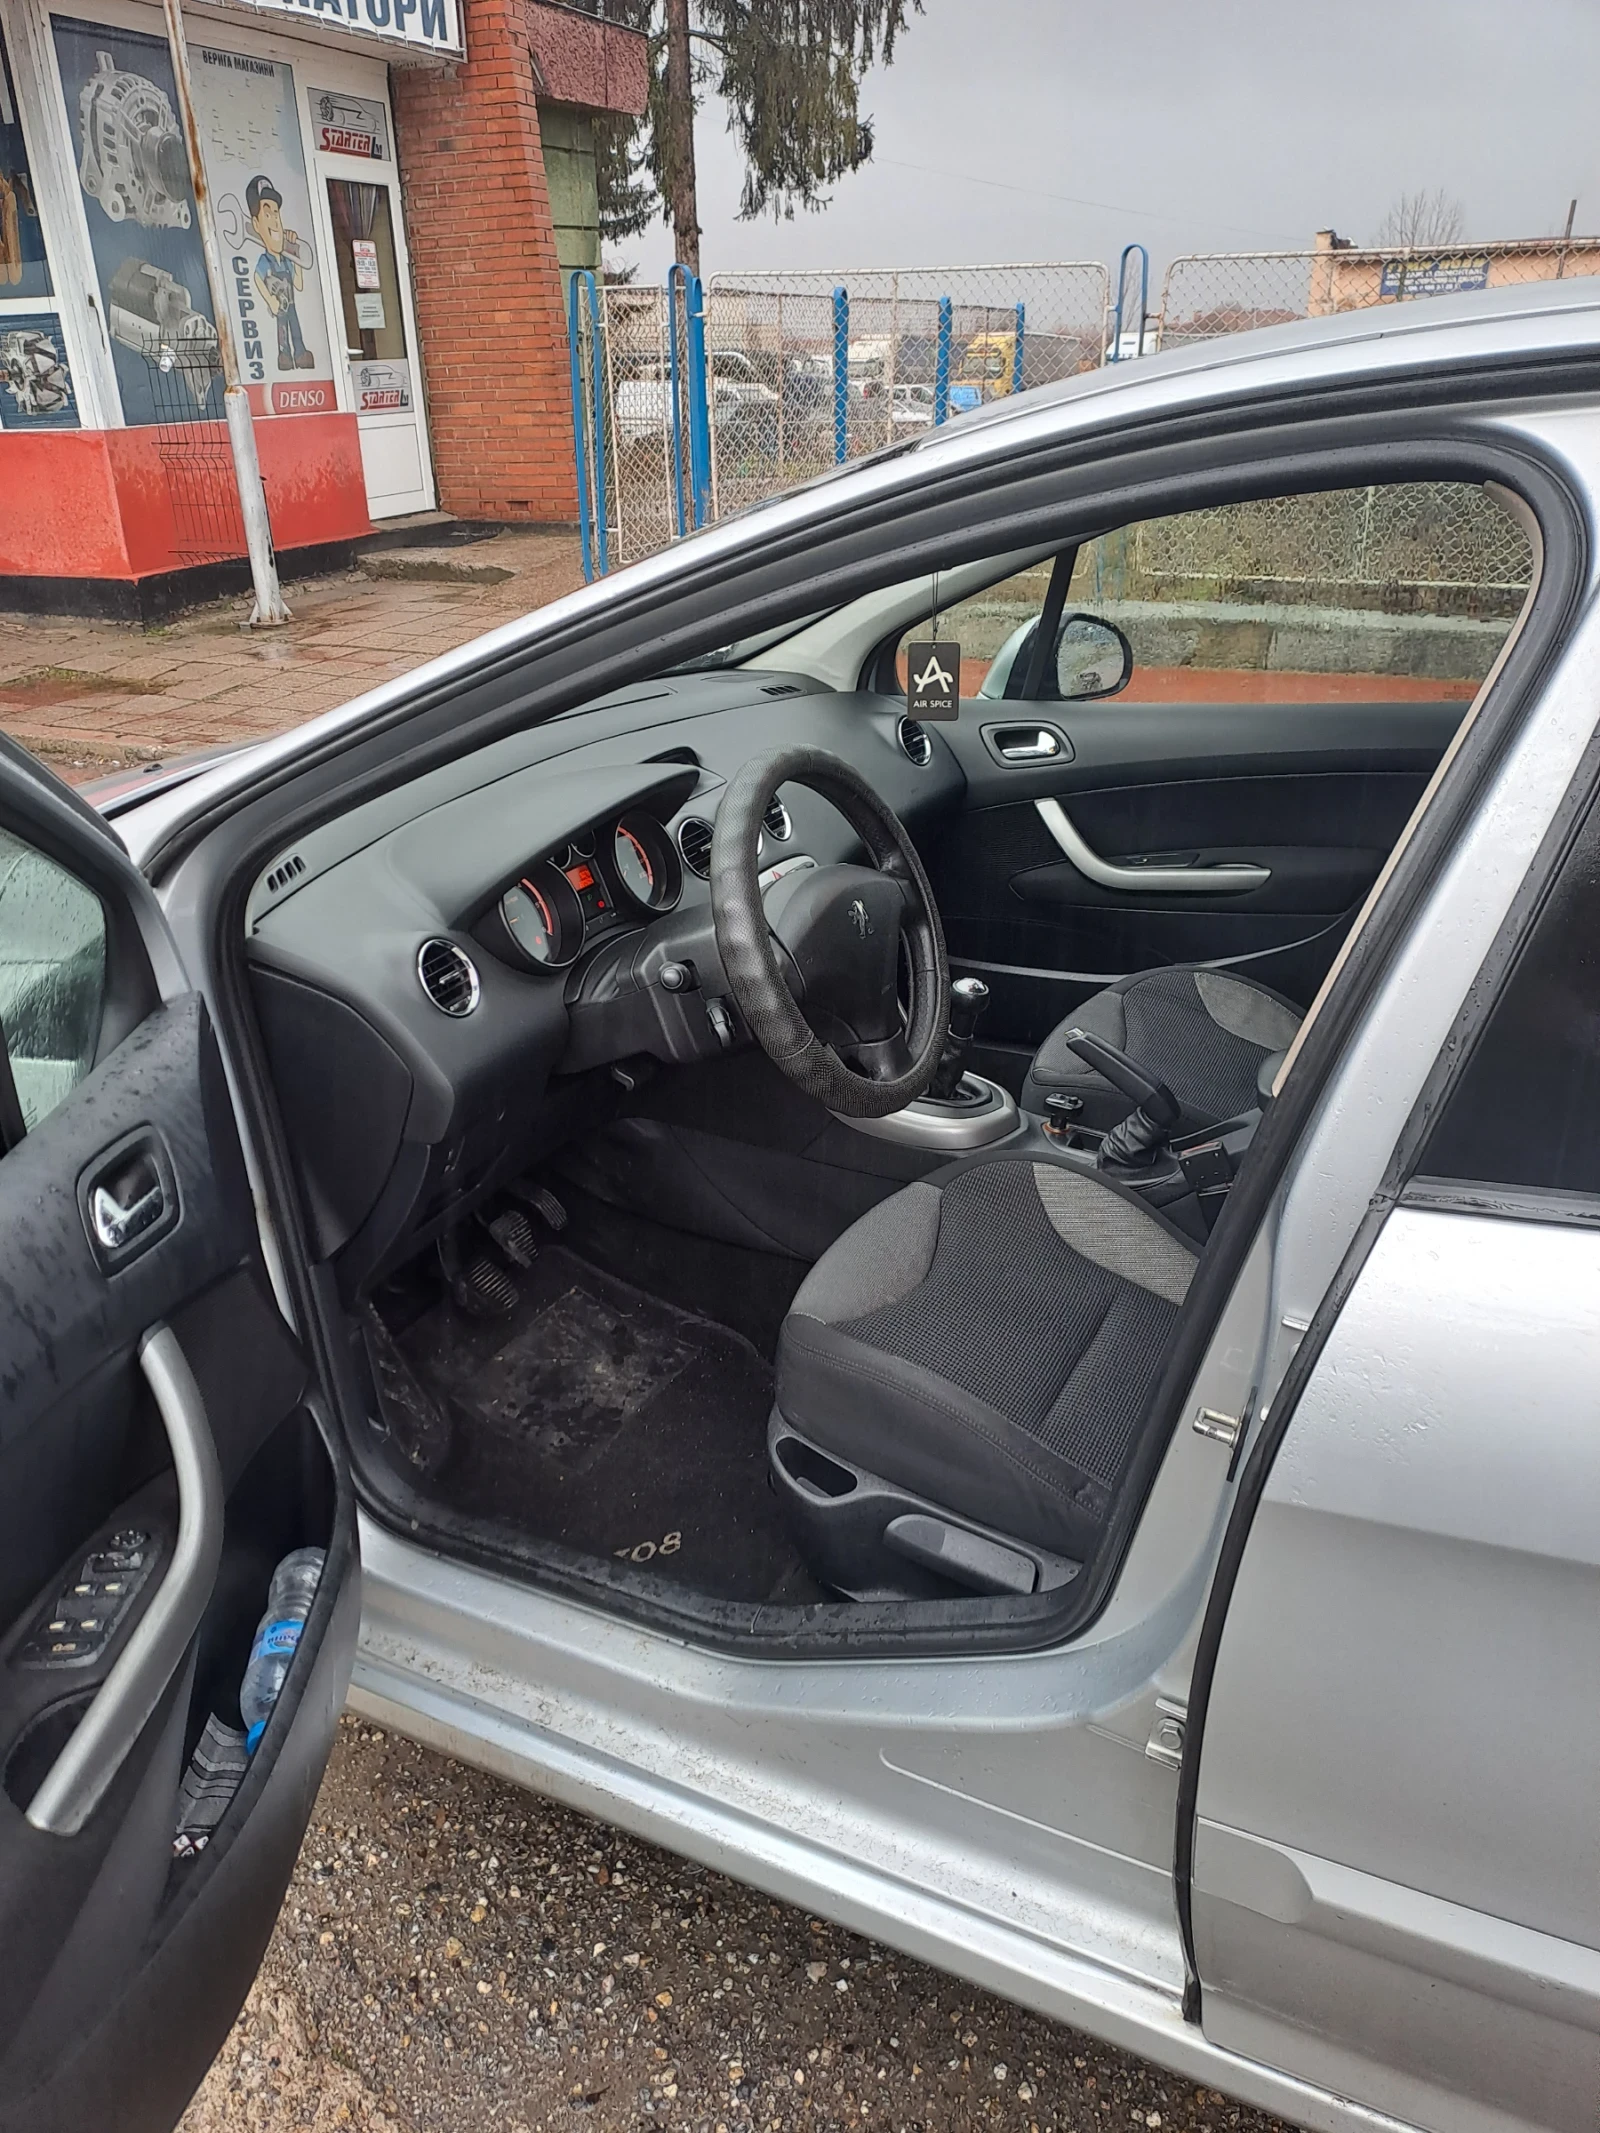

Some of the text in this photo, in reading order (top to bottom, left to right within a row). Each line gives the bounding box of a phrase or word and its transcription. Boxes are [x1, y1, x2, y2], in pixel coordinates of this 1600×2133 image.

[202, 50, 275, 77] ВЕРИГА МАГАЗИНИ
[231, 256, 265, 380] СЕРВИЗ
[279, 389, 325, 408] DENSO
[913, 700, 953, 708] AIR SPICE
